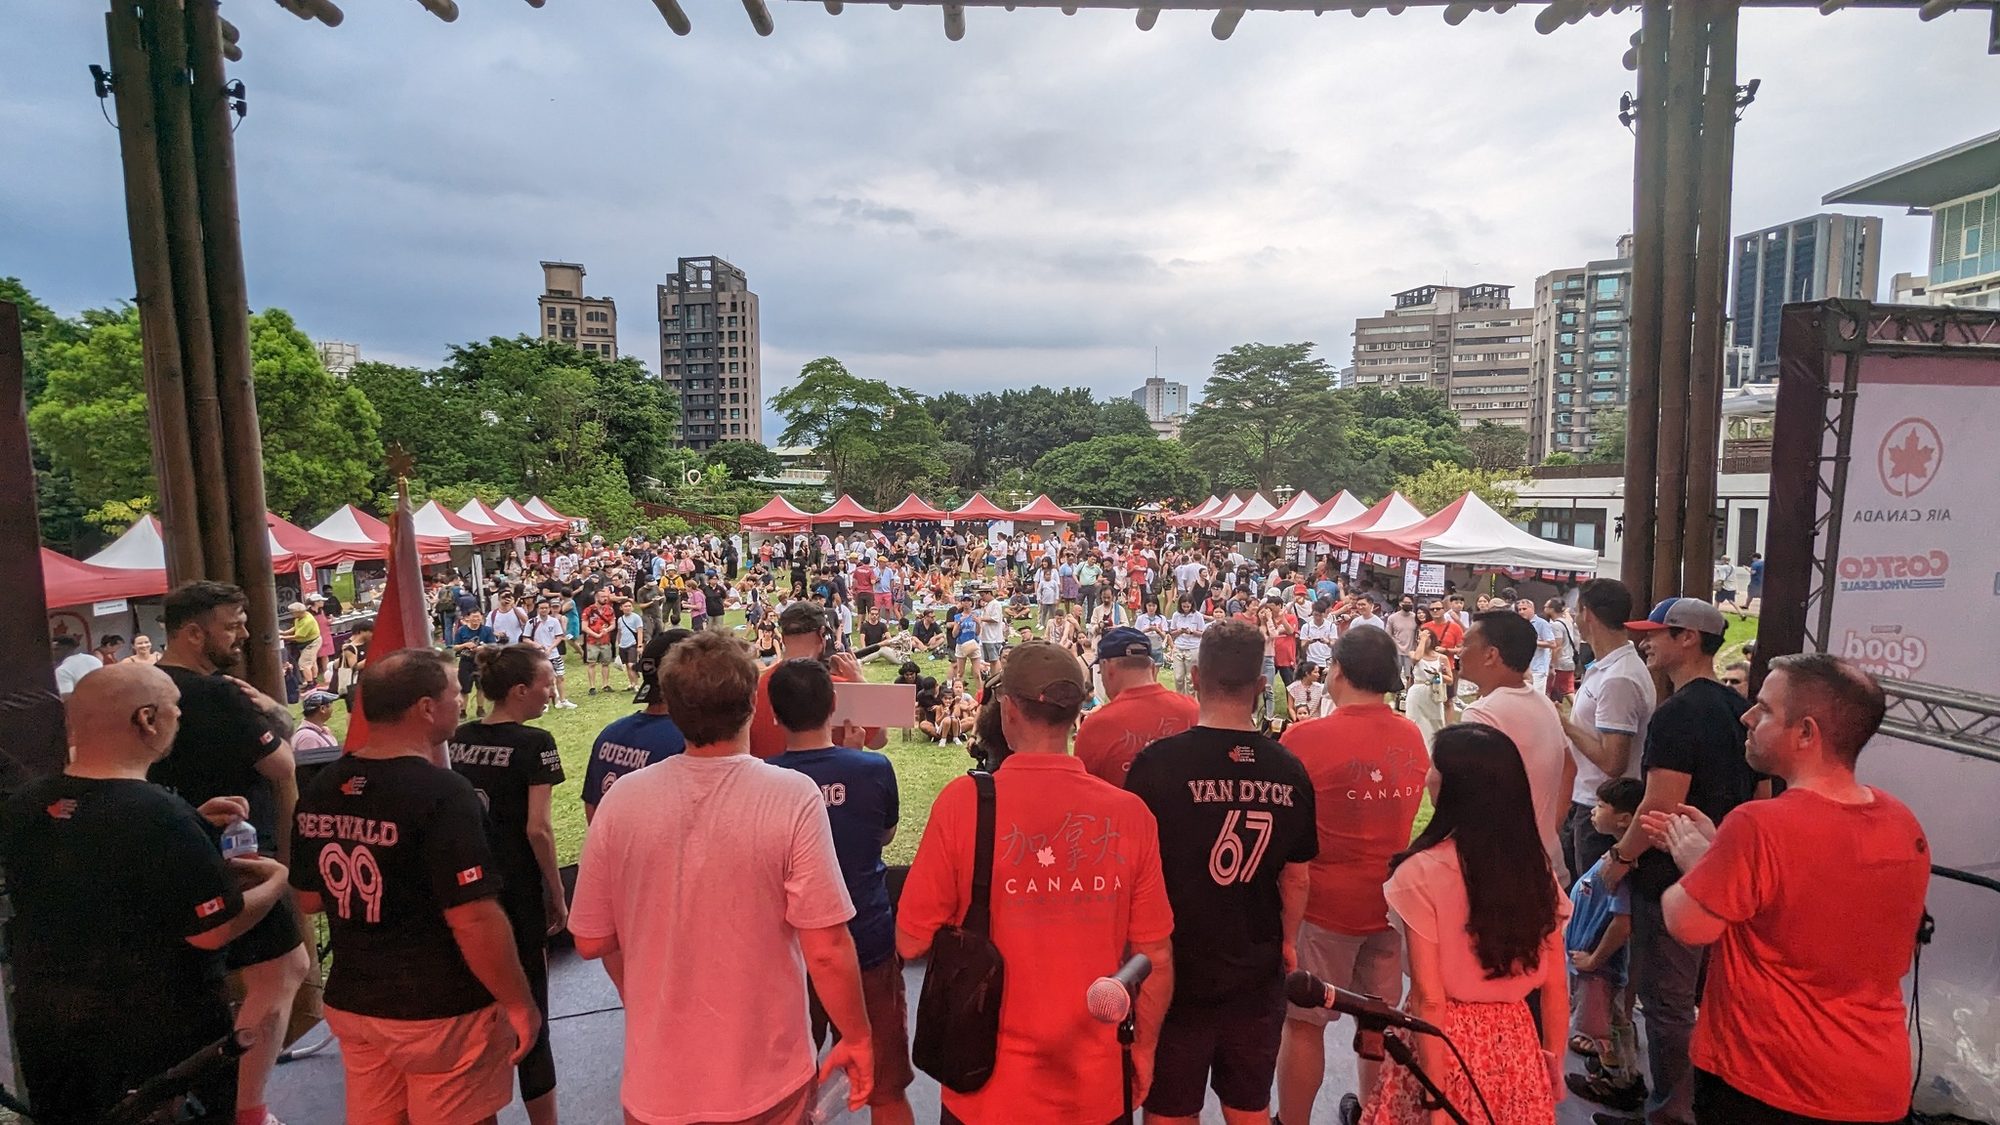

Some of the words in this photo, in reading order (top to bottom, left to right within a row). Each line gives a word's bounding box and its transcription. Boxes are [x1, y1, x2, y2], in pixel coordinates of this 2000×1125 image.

[449, 742, 514, 768] SMITH
[599, 741, 651, 769] GUEDON
[1188, 780, 1234, 803] VAN
[1239, 780, 1294, 807] DYCK
[1346, 785, 1421, 800] CANADA
[297, 812, 399, 847] SEEWALD
[1000, 812, 1126, 872] 加拿大
[1209, 810, 1273, 886] 67
[318, 842, 383, 923] 99
[1005, 875, 1122, 894] CANADA
